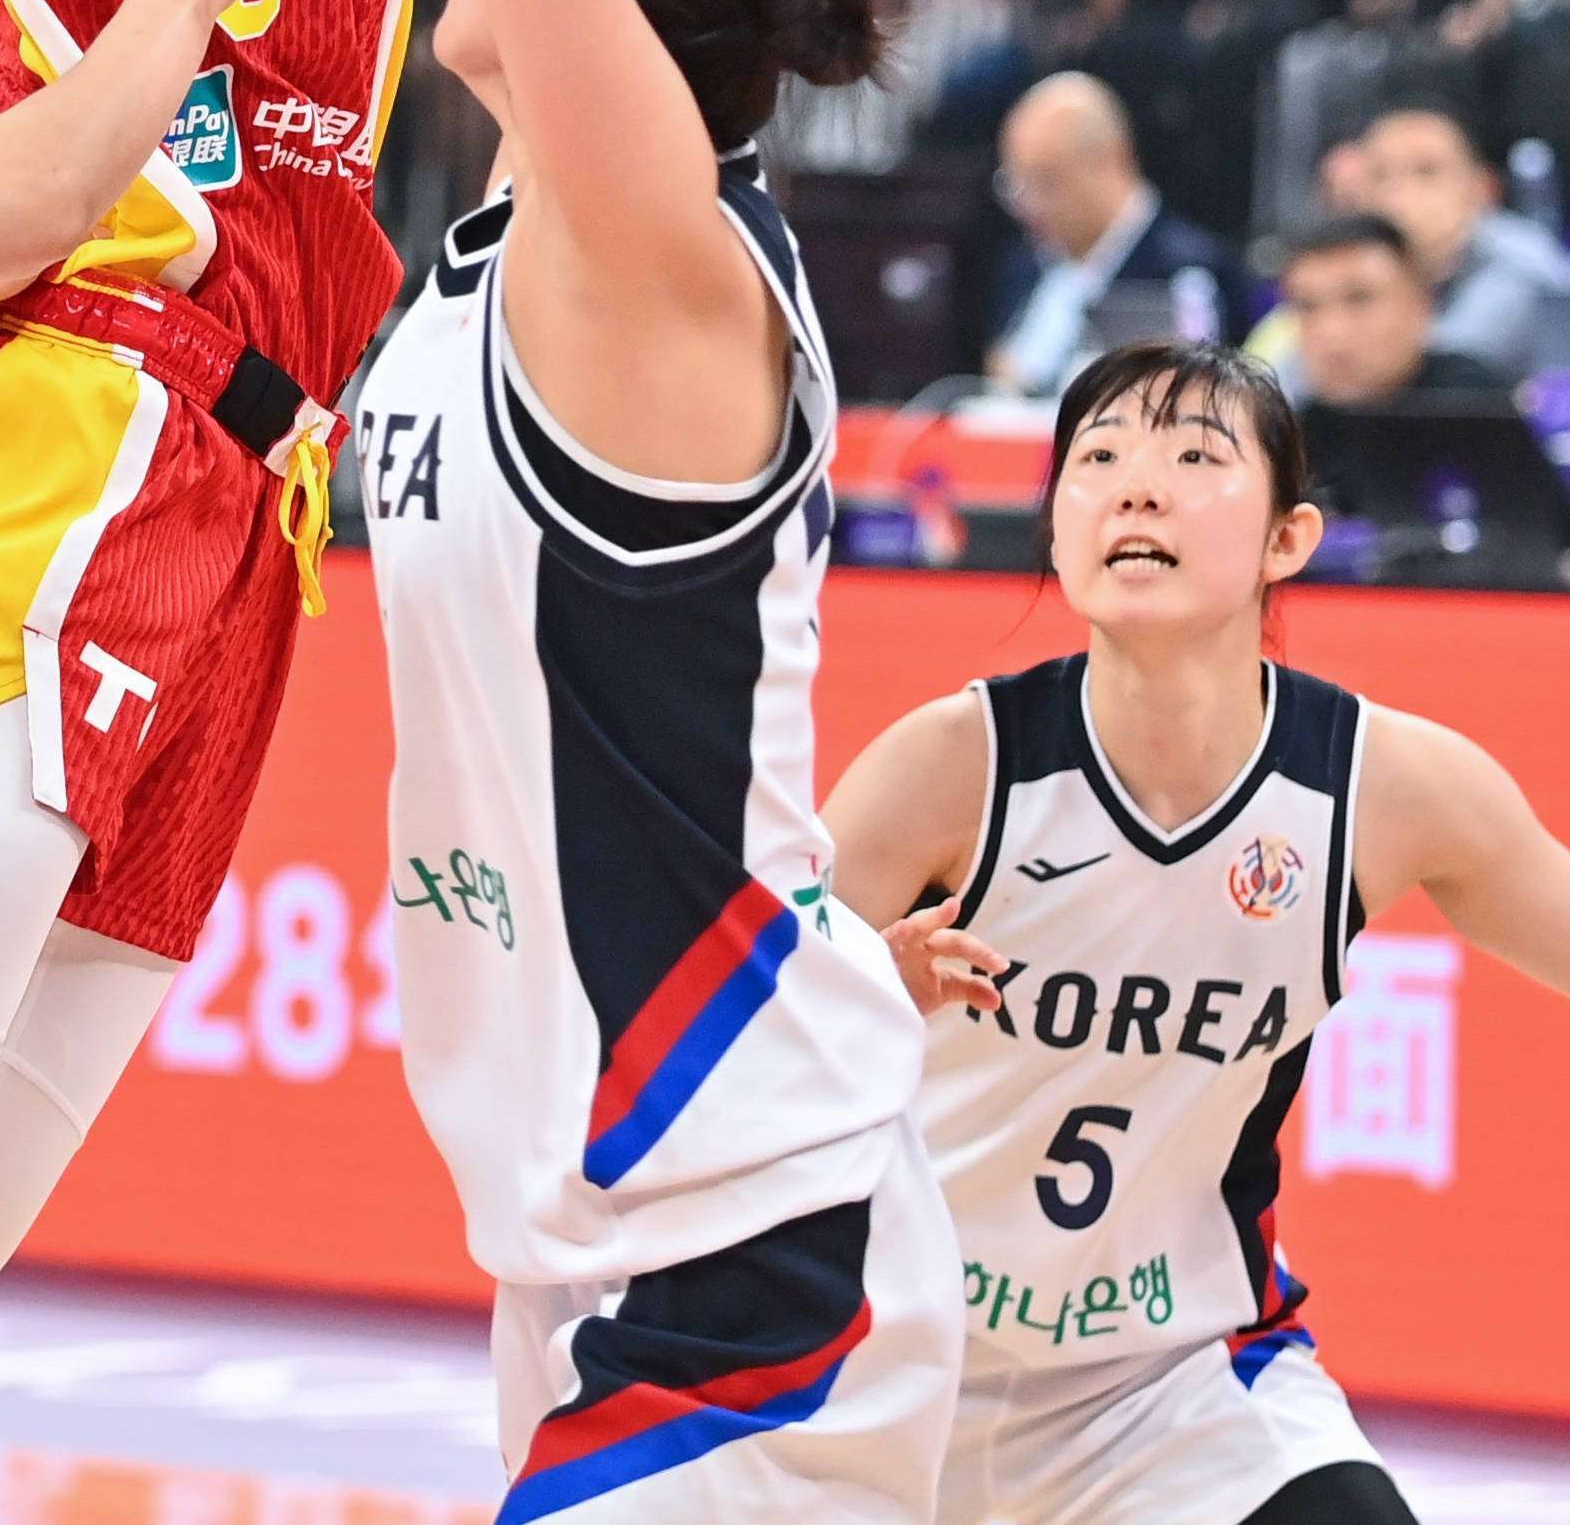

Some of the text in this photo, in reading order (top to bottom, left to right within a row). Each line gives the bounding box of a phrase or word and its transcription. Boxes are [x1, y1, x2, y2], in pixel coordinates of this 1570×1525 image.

[964, 959, 1288, 1064] KOREA
[1034, 1105, 1133, 1230] 5
[963, 1252, 1173, 1344] 하나은행
